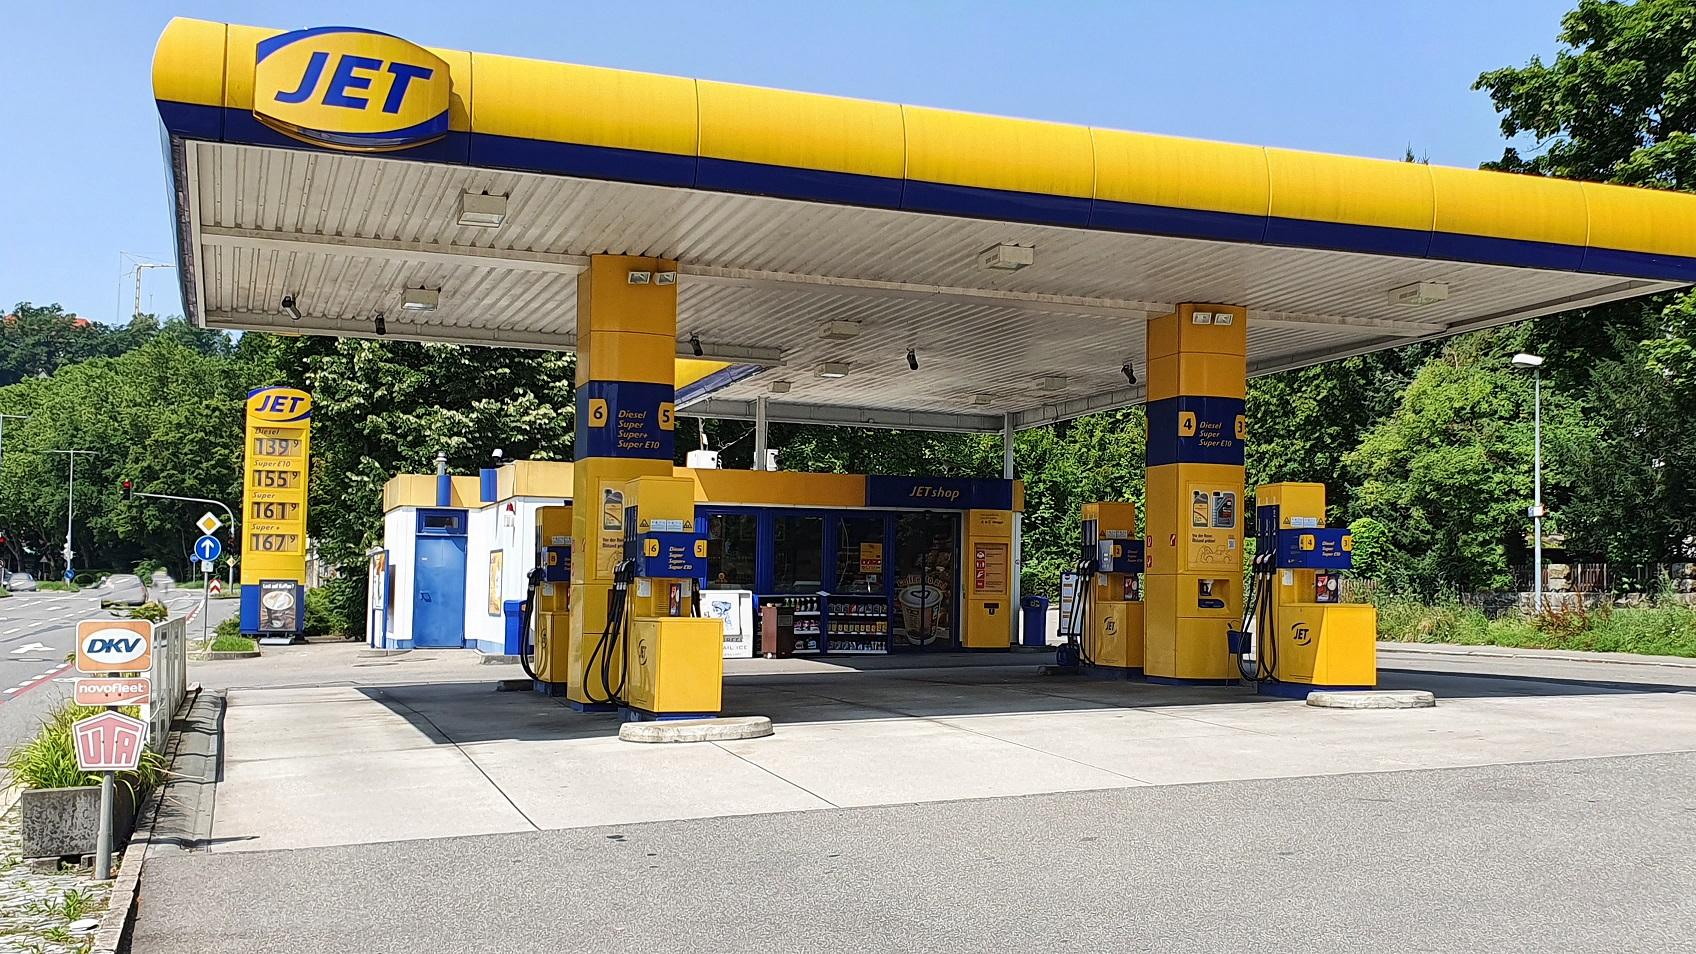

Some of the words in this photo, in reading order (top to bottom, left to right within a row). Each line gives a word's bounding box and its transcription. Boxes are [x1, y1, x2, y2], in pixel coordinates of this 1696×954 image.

[274, 51, 434, 114] JET
[254, 396, 304, 413] JET
[594, 406, 603, 420] 6
[618, 410, 646, 419] Diesel
[662, 410, 670, 423] 5
[618, 420, 644, 430] Super
[1184, 418, 1192, 430] 4
[1237, 420, 1242, 434] 3
[618, 430, 648, 440] Super+
[1200, 430, 1220, 438] Super
[254, 440, 289, 456] 139
[618, 440, 645, 450] Super
[1199, 439, 1220, 447] Super
[254, 460, 276, 468] Super
[254, 471, 288, 487] 155
[292, 472, 298, 480] 9
[253, 492, 275, 500] Super
[253, 502, 287, 519] 161
[291, 503, 297, 512] 9
[252, 523, 275, 531] Super
[252, 534, 286, 551] 167
[290, 535, 296, 543] 9
[651, 544, 657, 552] 6
[1293, 628, 1309, 640] JET
[87, 638, 142, 653] DKV
[80, 683, 144, 693] novofleet
[79, 717, 140, 764] UTA
